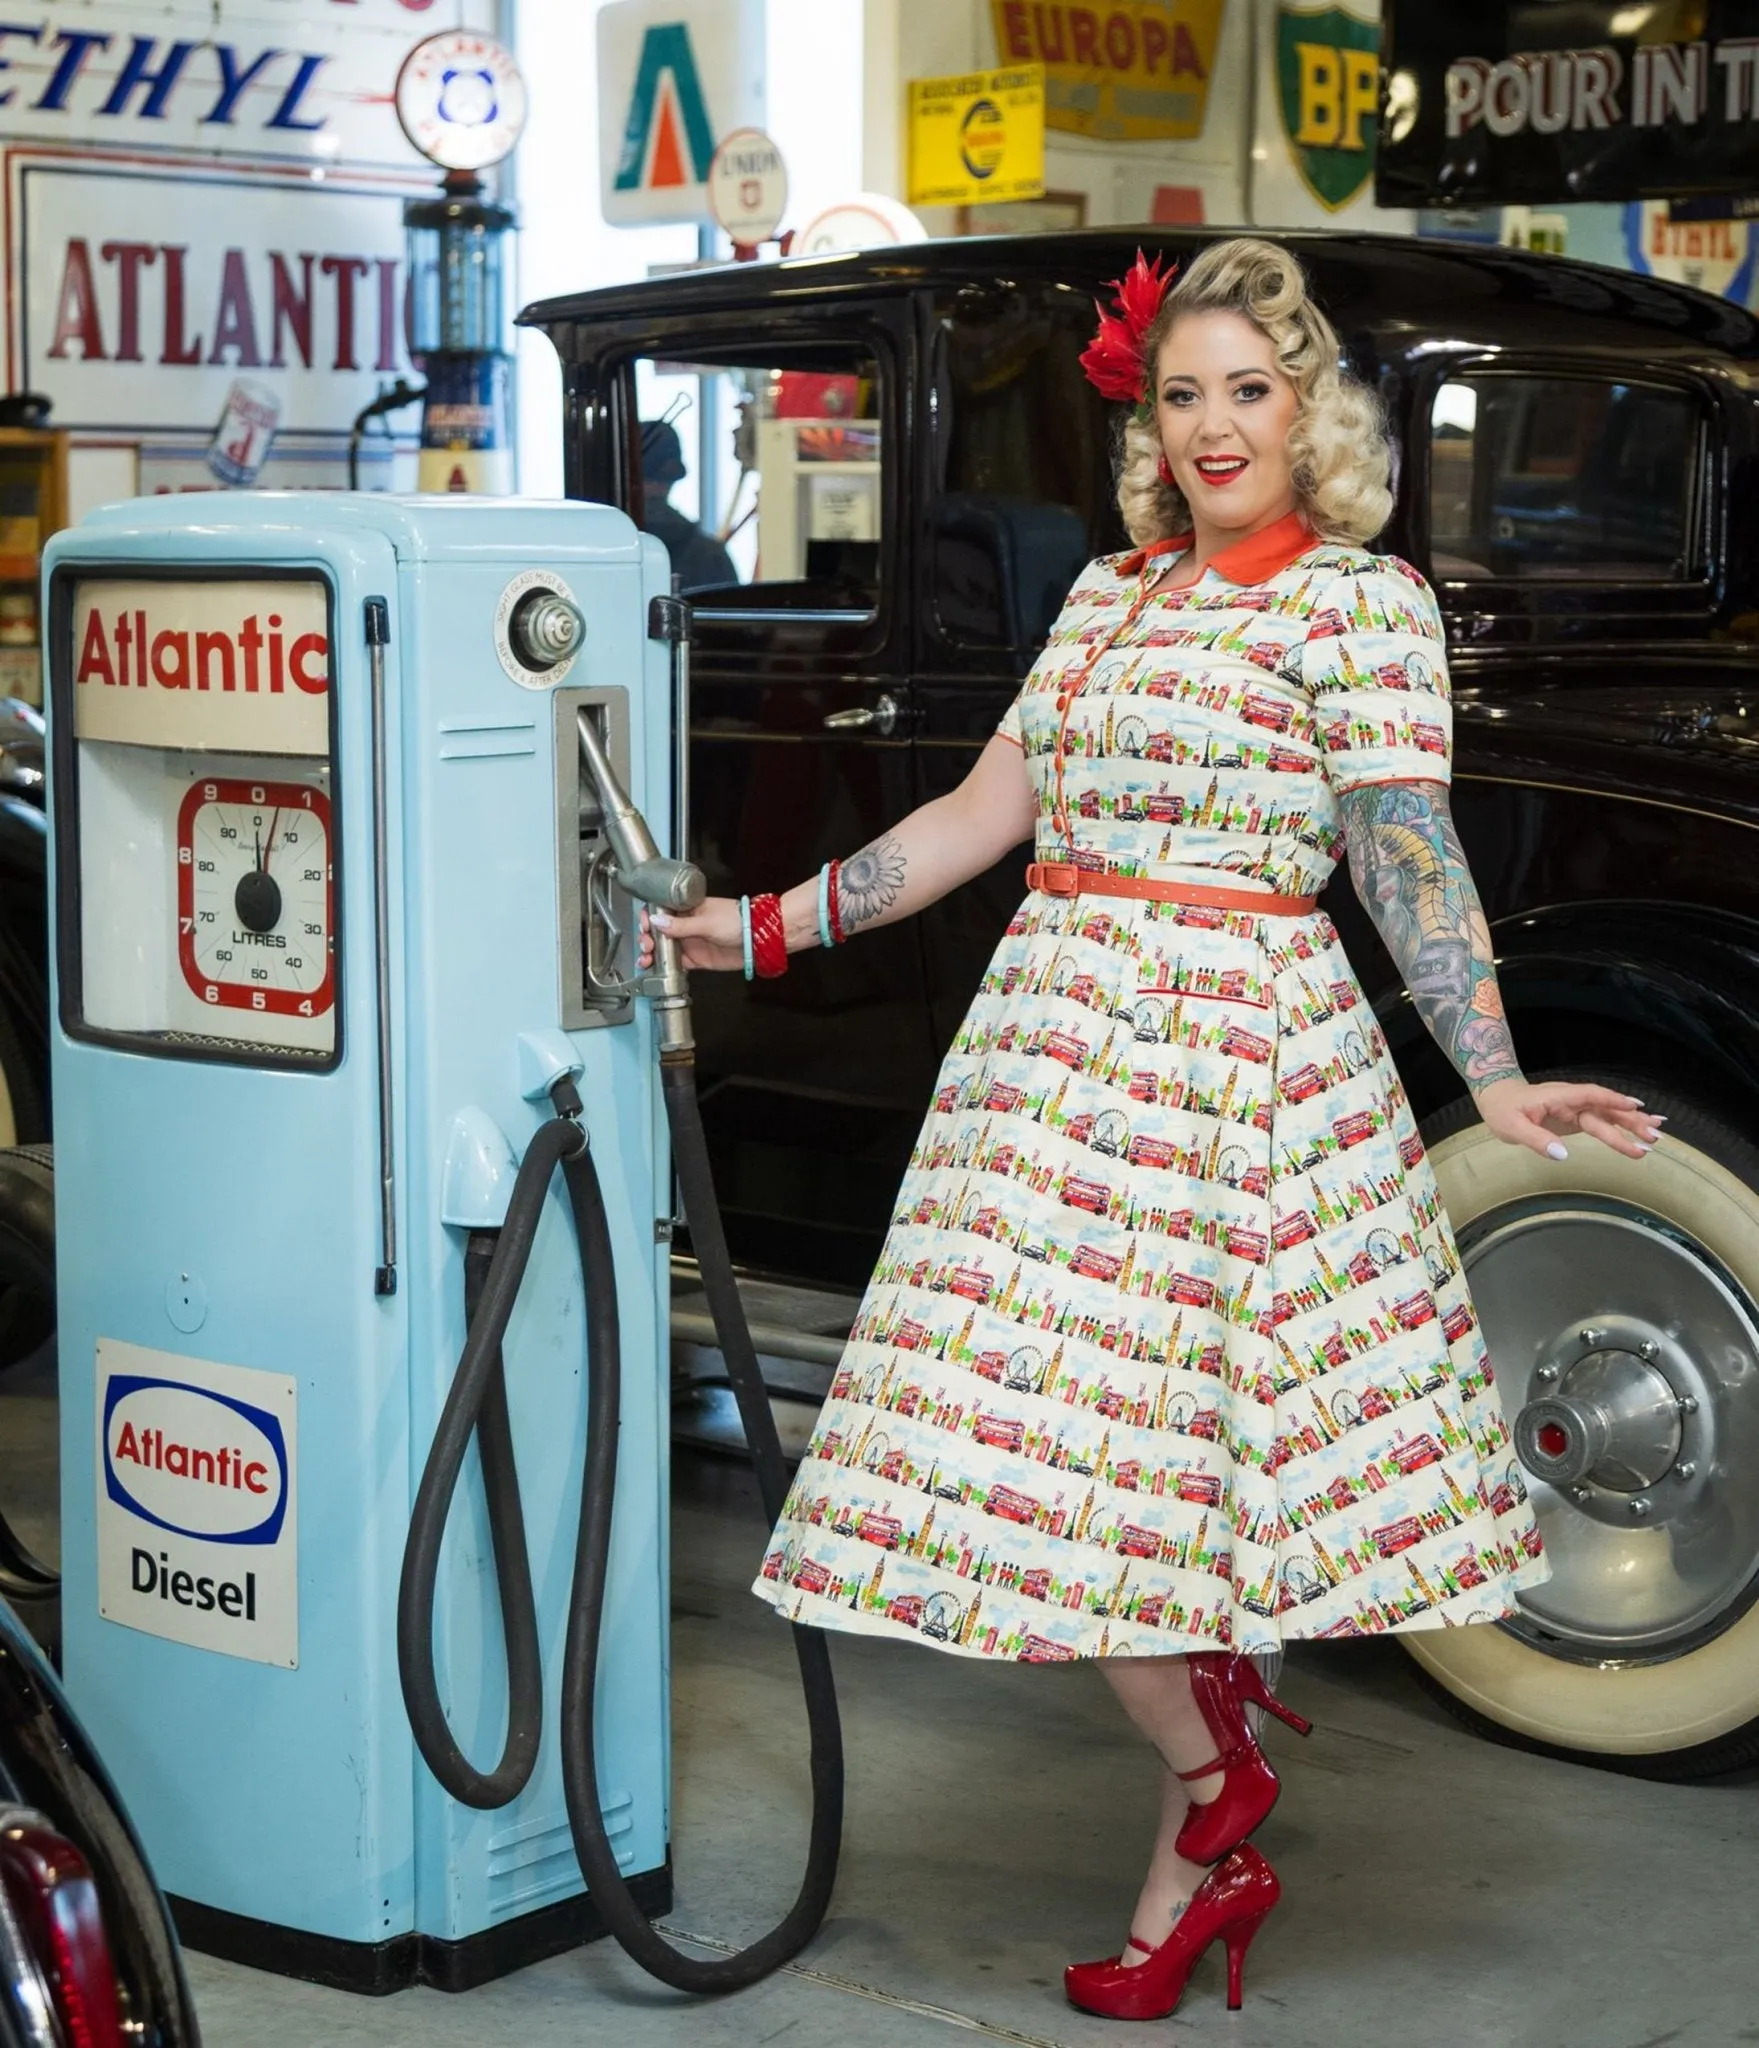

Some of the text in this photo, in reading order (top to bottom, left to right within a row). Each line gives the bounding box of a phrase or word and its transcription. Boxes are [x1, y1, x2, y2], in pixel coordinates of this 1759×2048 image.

[1003, 0, 1207, 80] EUROPA
[1293, 40, 1379, 151] BP
[1445, 38, 1759, 137] POUR IN T
[48, 237, 420, 371] ATLANTI
[511, 573, 533, 593] GLASS
[535, 572, 556, 585] MUST
[77, 608, 328, 694] Atlantic
[529, 674, 553, 685] AFTER
[204, 784, 217, 800] 9
[252, 786, 265, 803] 0
[302, 790, 311, 808] 1
[253, 816, 262, 827] 0
[220, 827, 237, 839] 90
[284, 832, 298, 844] 10
[179, 847, 191, 864] 8
[198, 861, 215, 872] 80
[304, 869, 321, 881] 20
[180, 917, 193, 934] 7
[199, 911, 215, 923] 70
[304, 923, 322, 935] 30
[232, 930, 286, 948] LITRES
[216, 950, 232, 961] 60
[285, 957, 302, 969] 40
[251, 969, 268, 980] 50
[205, 985, 219, 1002] 6
[252, 992, 266, 1009] 5
[298, 999, 313, 1016] 4
[115, 1421, 268, 1494] Atlantic
[131, 1547, 256, 1621] Diesel
